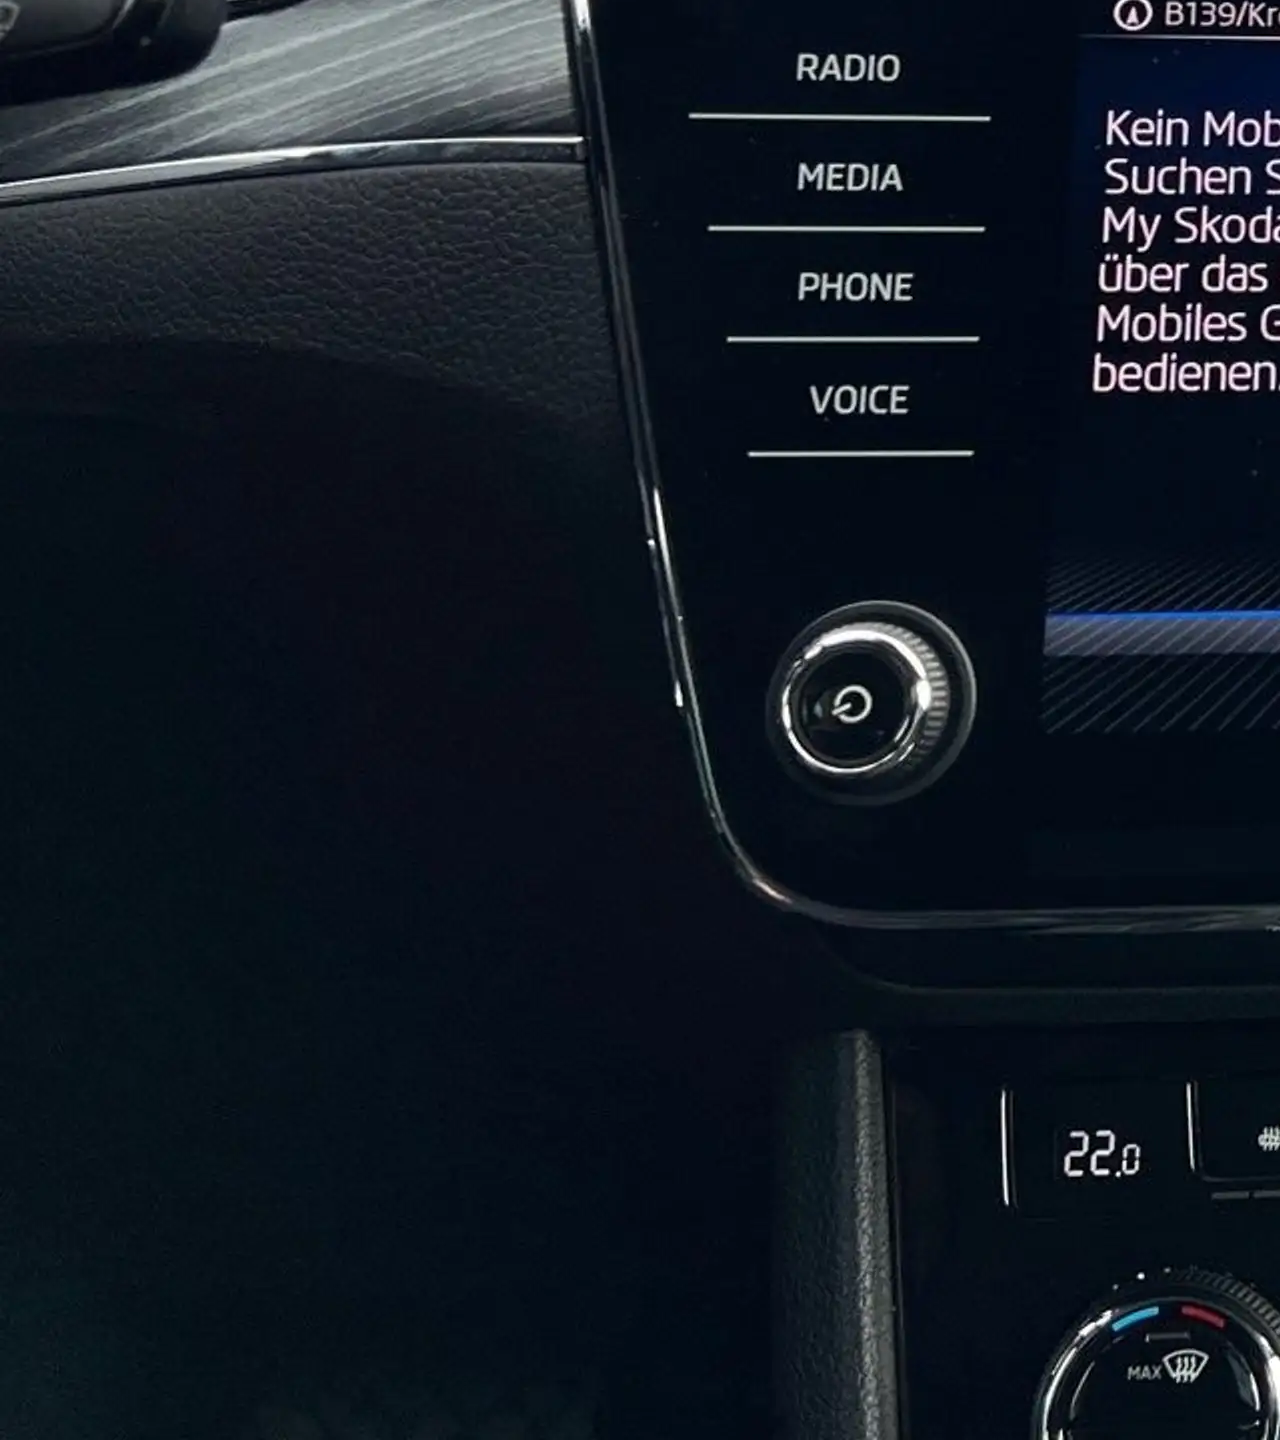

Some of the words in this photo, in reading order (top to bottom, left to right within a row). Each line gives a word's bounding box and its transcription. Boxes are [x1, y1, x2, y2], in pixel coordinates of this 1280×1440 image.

[796, 53, 901, 82] RADIO
[1106, 108, 1190, 147] Kein
[797, 162, 903, 192] MEDIA
[1104, 156, 1252, 195] Suchen
[1102, 206, 1162, 253] My
[798, 271, 914, 302] PHONE
[1098, 249, 1190, 293] über
[1201, 253, 1269, 293] das
[1097, 302, 1248, 342] Mobiles
[809, 384, 910, 415] VOICE
[1063, 1129, 1141, 1178] 22.0
[1127, 1363, 1163, 1381] MAX
